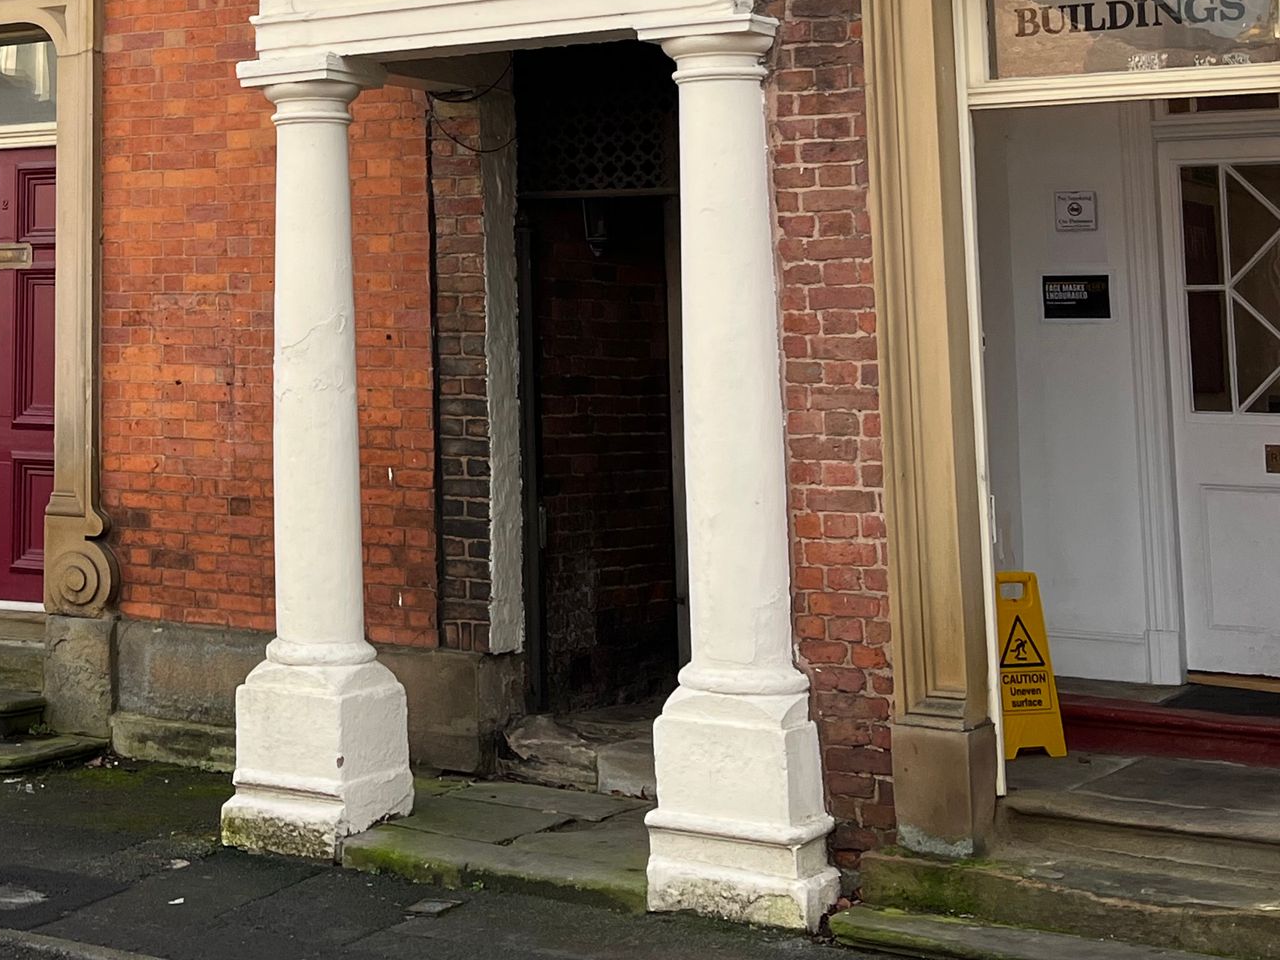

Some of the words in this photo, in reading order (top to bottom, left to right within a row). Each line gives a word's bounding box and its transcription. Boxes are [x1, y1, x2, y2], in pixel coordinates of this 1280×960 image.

[2, 200, 9, 211] 2
[1002, 673, 1046, 685] CAUTION
[1010, 687, 1041, 696] Uneven
[1012, 698, 1042, 707] surface
